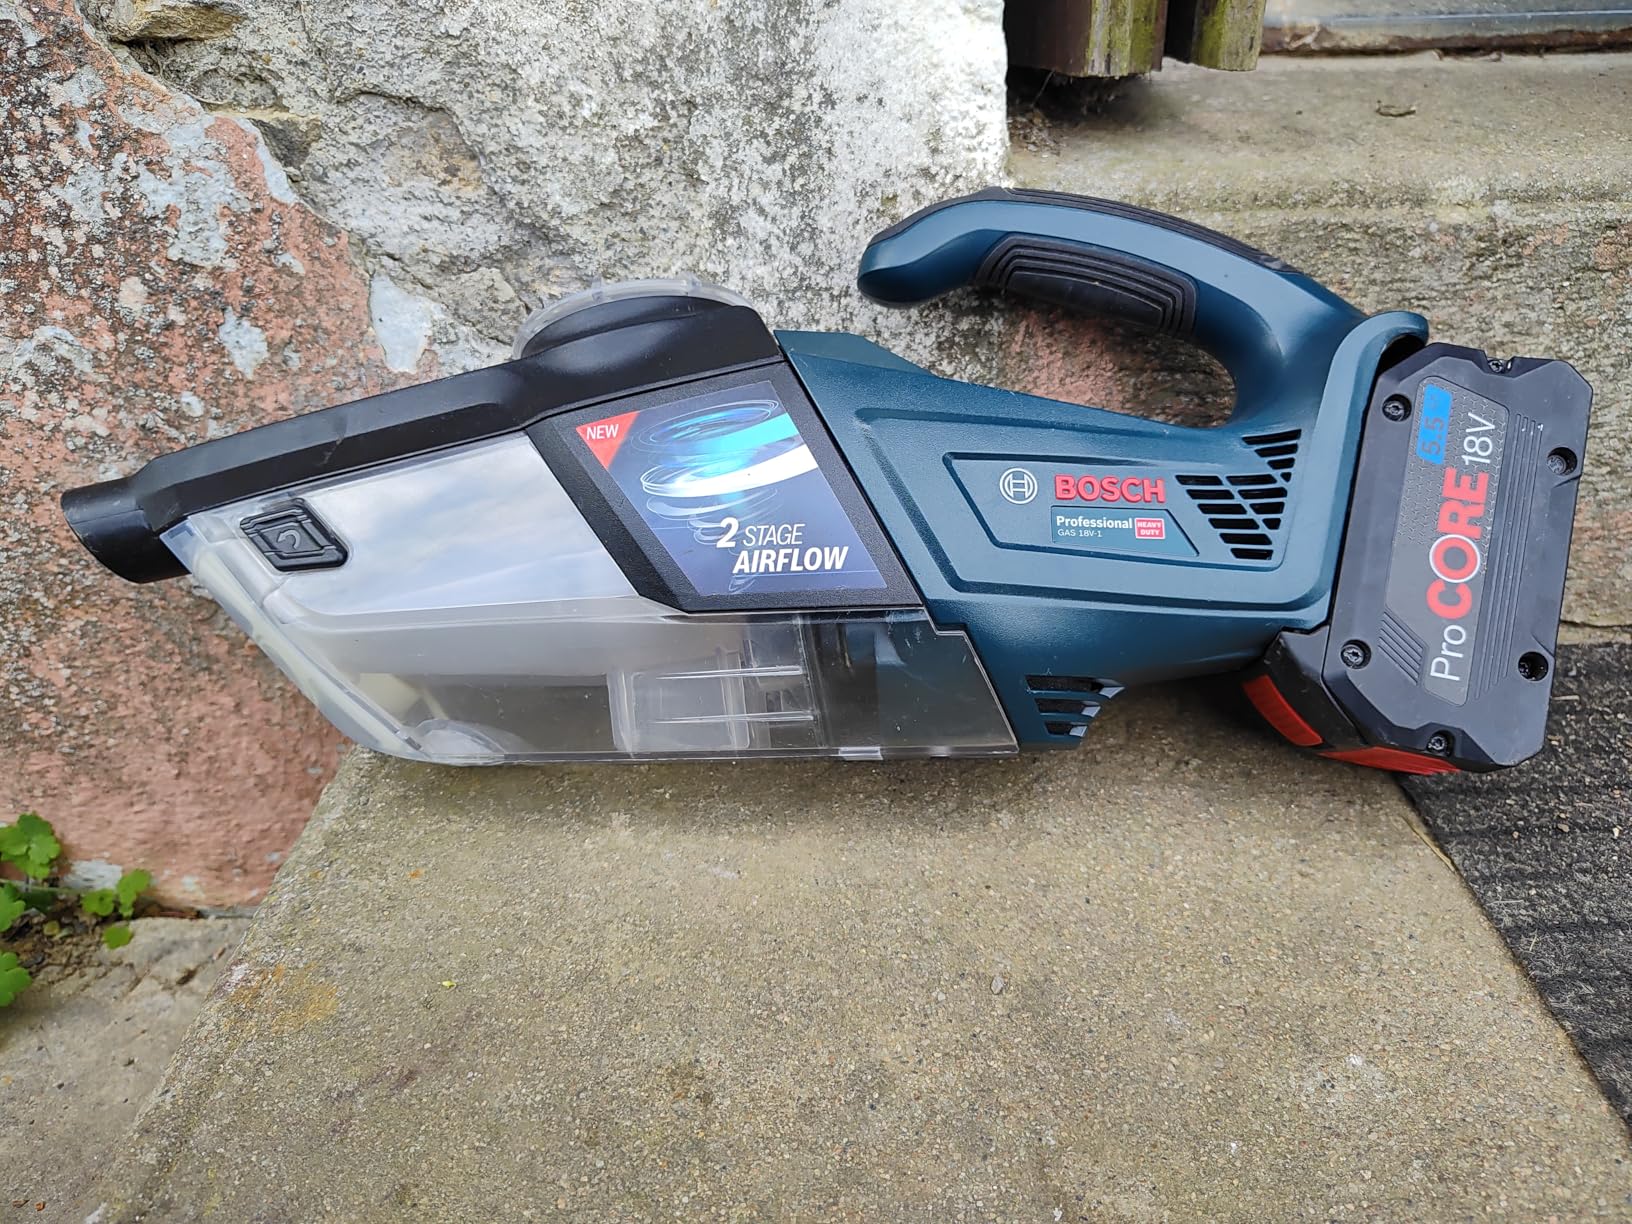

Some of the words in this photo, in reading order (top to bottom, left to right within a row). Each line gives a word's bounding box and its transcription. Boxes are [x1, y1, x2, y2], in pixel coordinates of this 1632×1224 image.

[586, 424, 619, 440] NEW
[1422, 416, 1445, 456] 5.5
[1461, 411, 1496, 466] 18V
[1054, 474, 1166, 504] BOSCH
[716, 517, 740, 548] 2
[742, 523, 805, 545] STAGE
[1056, 515, 1133, 529] Professional
[1057, 528, 1077, 537] GAS
[1079, 529, 1103, 538] 18V-1
[1140, 528, 1160, 536] DUTY
[732, 546, 849, 574] AIRFLOW
